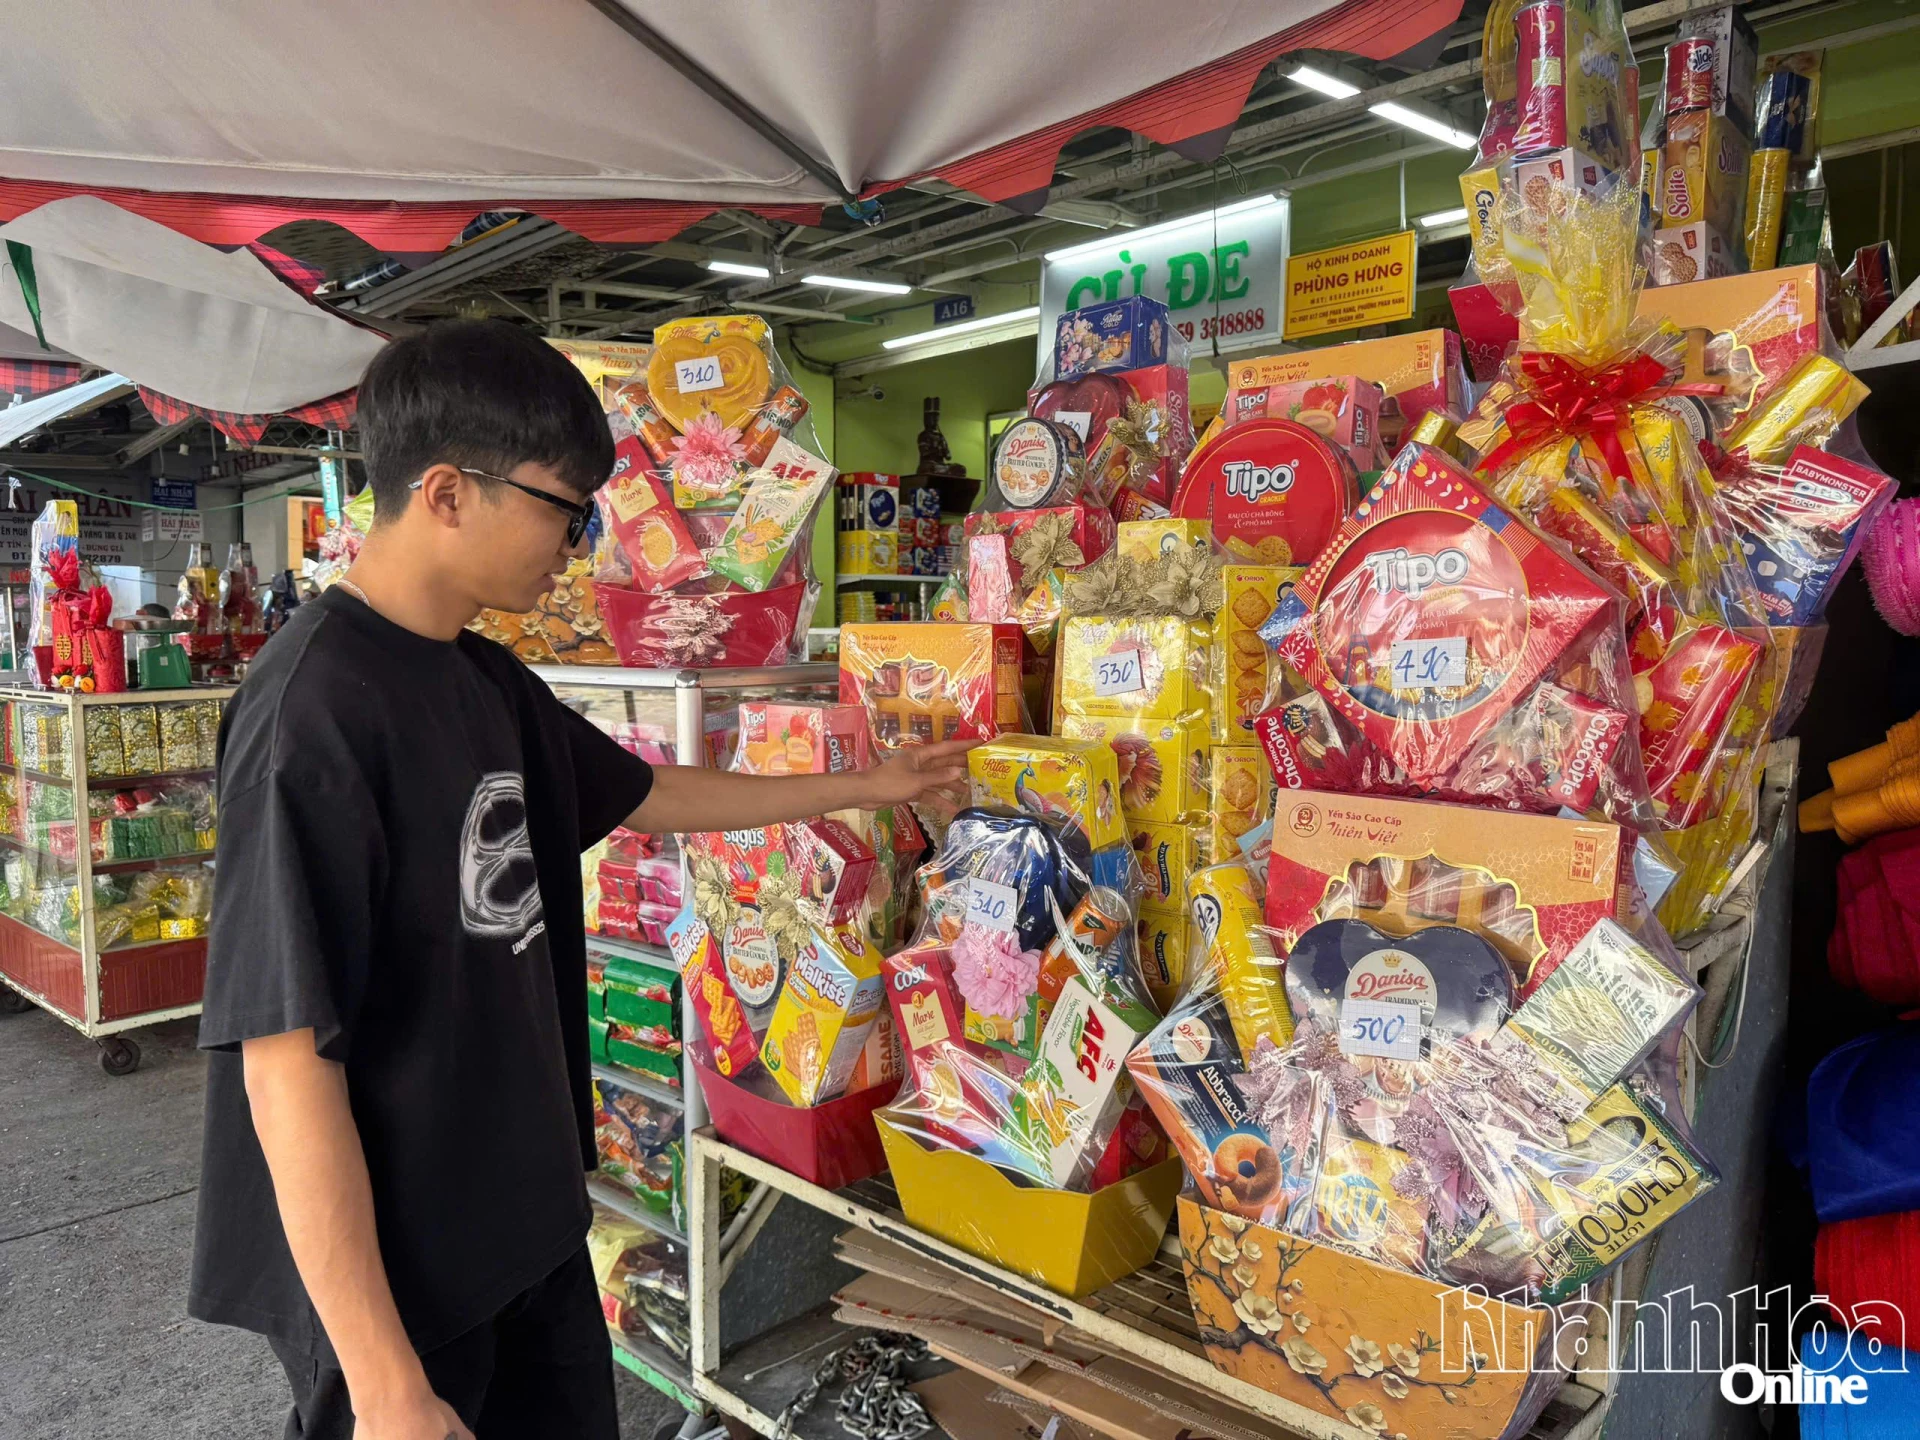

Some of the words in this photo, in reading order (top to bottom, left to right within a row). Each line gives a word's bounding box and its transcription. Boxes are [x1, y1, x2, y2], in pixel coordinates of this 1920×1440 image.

[1668, 168, 1691, 219] Solite
[1306, 257, 1323, 272] HỘ
[1324, 253, 1350, 268] KINH
[1351, 245, 1391, 261] DOANH
[1165, 239, 1250, 311] ĐE
[1293, 272, 1350, 296] PHÙNG
[1354, 261, 1404, 285] HƯNG
[941, 300, 968, 319] A16
[1199, 306, 1265, 341] 3518888
[680, 364, 715, 385] 310
[1272, 364, 1284, 372] Sào
[1297, 361, 1310, 370] Cấp
[1286, 369, 1308, 383] Việt
[1235, 391, 1267, 411] Tipo
[1354, 408, 1364, 448] Tipo
[1007, 435, 1048, 458] Danisa
[1091, 446, 1112, 476] ustas
[619, 487, 643, 505] Marie
[1223, 460, 1295, 503] Tipo
[1795, 464, 1868, 499] BABYMONSTER
[1228, 511, 1240, 519] RAU
[1240, 510, 1249, 519] CỦ
[1249, 510, 1265, 518] CHÀ
[1265, 509, 1285, 517] BÔNG
[1260, 495, 1286, 504] CRACKER
[83, 528, 103, 540] VÀNG
[1364, 546, 1471, 601] Tipo
[1431, 620, 1448, 629] MAI
[1438, 607, 1464, 620] BÔNG
[1098, 659, 1135, 686] 530
[1395, 645, 1450, 683] 490
[745, 711, 766, 727] Tipo
[829, 736, 844, 773] Tipo
[981, 757, 1012, 773] Ritaz
[1267, 716, 1302, 790] ChocoPie
[1561, 712, 1611, 797] ChocoPie
[986, 770, 1007, 780] GOLD
[1327, 809, 1343, 820] Yến
[1344, 811, 1363, 822] Sào
[1364, 813, 1382, 823] Cao
[1383, 812, 1402, 827] Cấp
[1327, 820, 1363, 840] Thiên
[1367, 826, 1399, 846] Việt
[825, 822, 862, 859] ChocoPie
[970, 889, 1006, 920] 310
[675, 918, 706, 972] Malkist
[732, 923, 767, 947] Danisa
[1599, 929, 1619, 949] Tipo
[794, 950, 846, 1007] Malkist
[893, 963, 928, 991] COSY
[1350, 968, 1429, 1000] Danisa
[1573, 946, 1659, 1027] Matcha
[912, 1009, 935, 1027] Marie
[1060, 997, 1081, 1031] Vegetable
[1353, 1013, 1406, 1045] 500
[1053, 1027, 1067, 1048] Flavor
[1077, 1004, 1106, 1084] AFC
[1177, 1023, 1206, 1055] Danisa
[1201, 1065, 1247, 1124] Abbracci
[1533, 1155, 1688, 1288] CHOCOLAT
[1607, 1220, 1646, 1255] LOTTE
